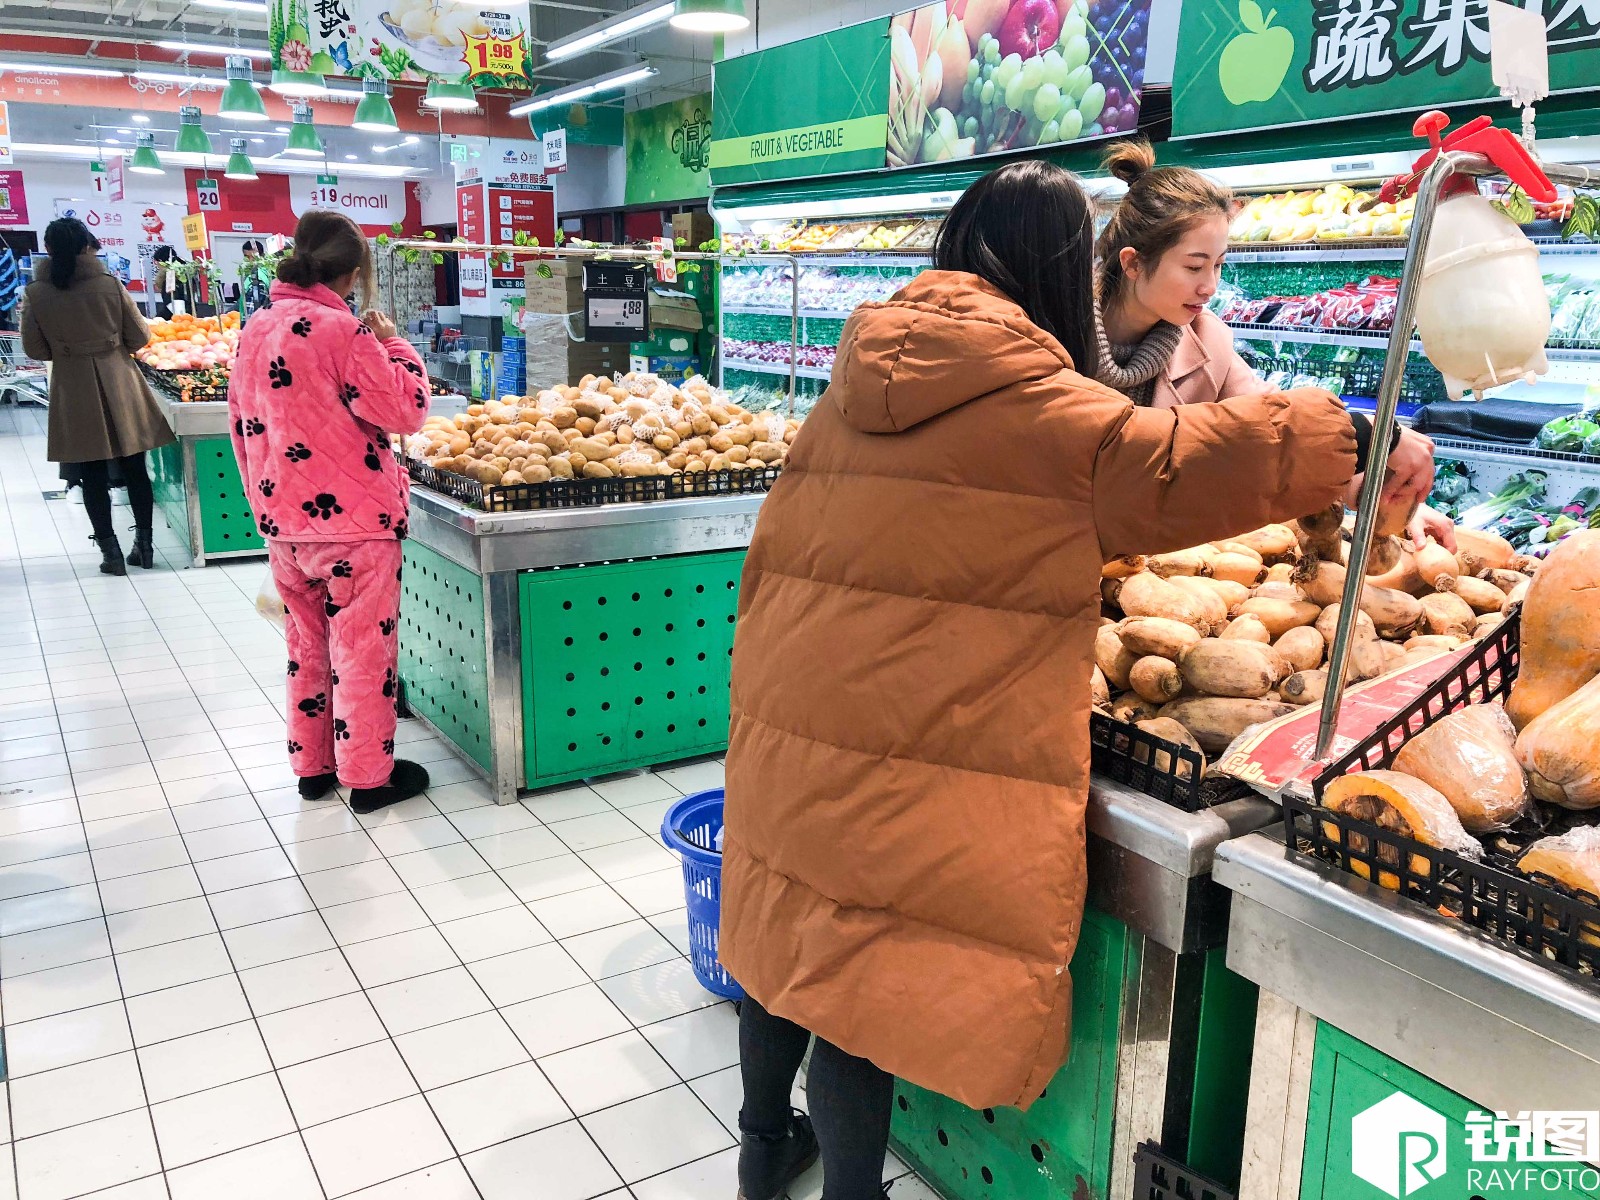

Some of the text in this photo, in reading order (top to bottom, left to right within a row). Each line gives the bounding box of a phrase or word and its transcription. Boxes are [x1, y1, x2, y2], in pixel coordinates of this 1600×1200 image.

[491, 27, 511, 36] 水晶梨
[474, 43, 513, 68] 1.98
[750, 127, 844, 158] FRUIT & VEGETABLE
[200, 192, 218, 205] 20
[320, 188, 337, 202] 19
[341, 193, 388, 208] dmall
[515, 280, 525, 288] 86
[597, 273, 635, 285] 土豆
